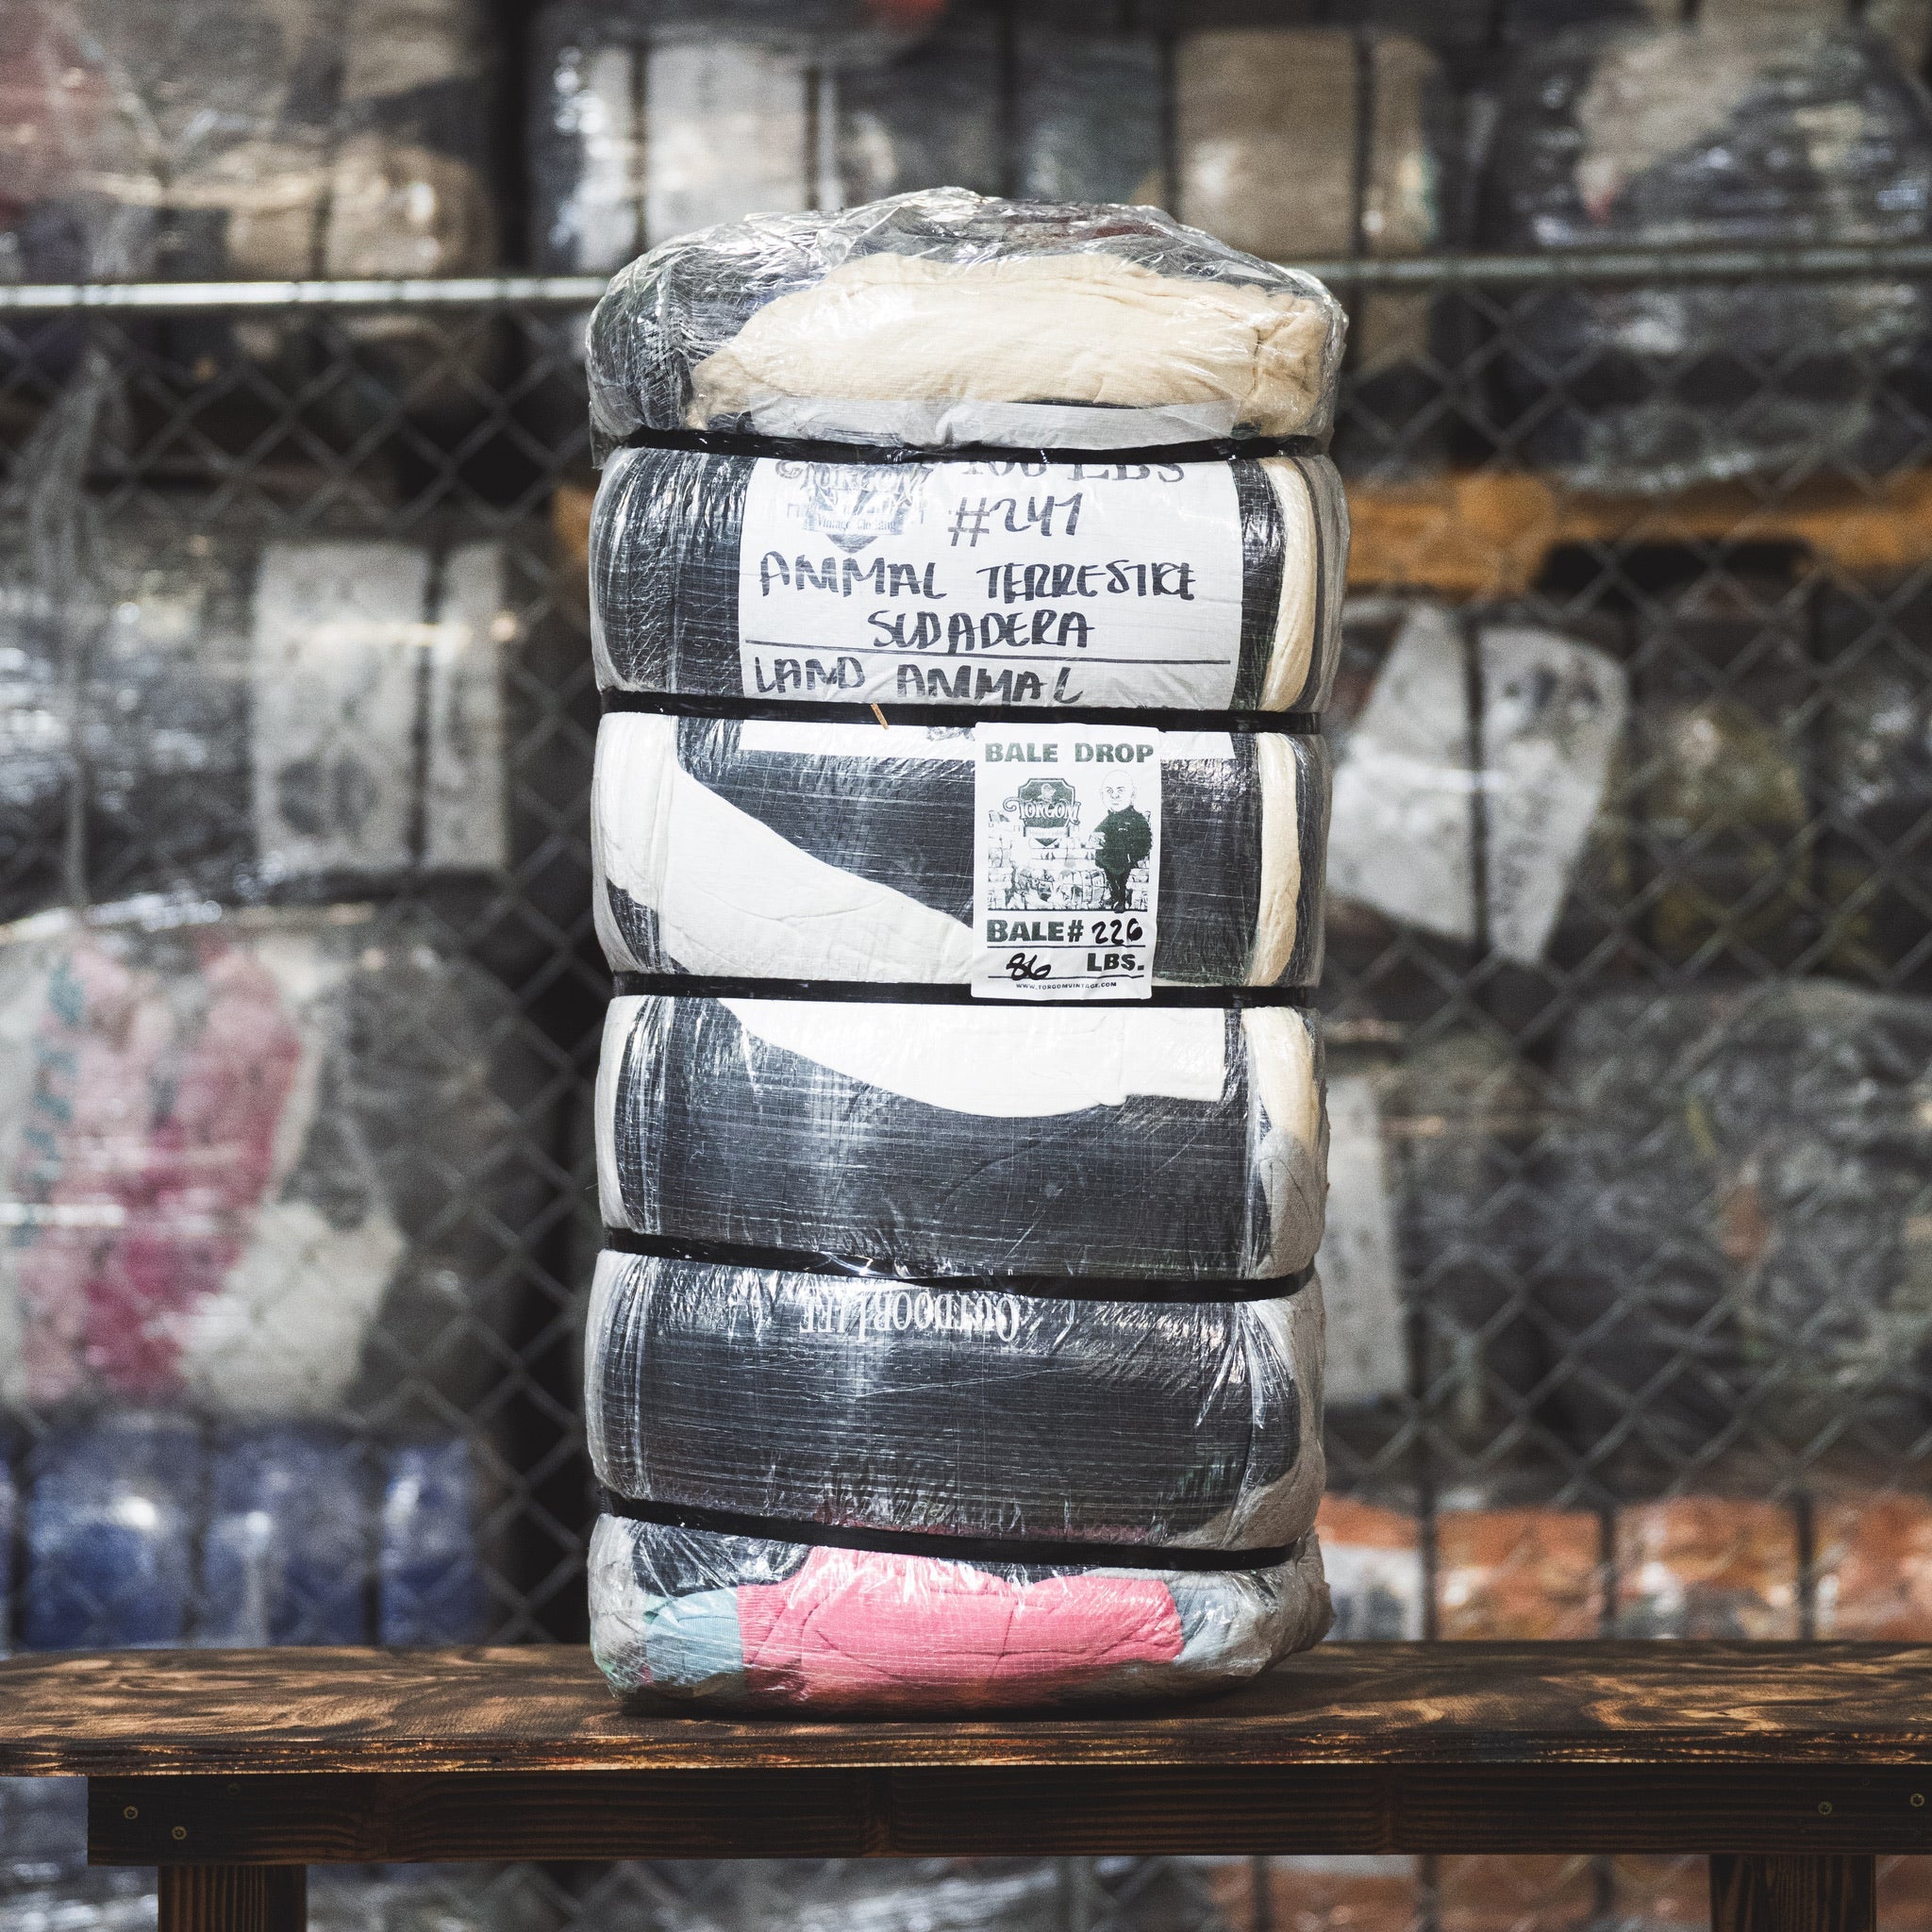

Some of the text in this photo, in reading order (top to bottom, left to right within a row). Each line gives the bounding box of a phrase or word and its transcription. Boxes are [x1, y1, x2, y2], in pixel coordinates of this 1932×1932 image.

[868, 609, 1095, 653] SUDADERA
[755, 657, 865, 693] LAND
[985, 742, 1154, 763] BALE DROP
[1003, 796, 1081, 825] TORGOM
[1091, 918, 1143, 944] 226
[1006, 952, 1144, 980] 86 LBS.
